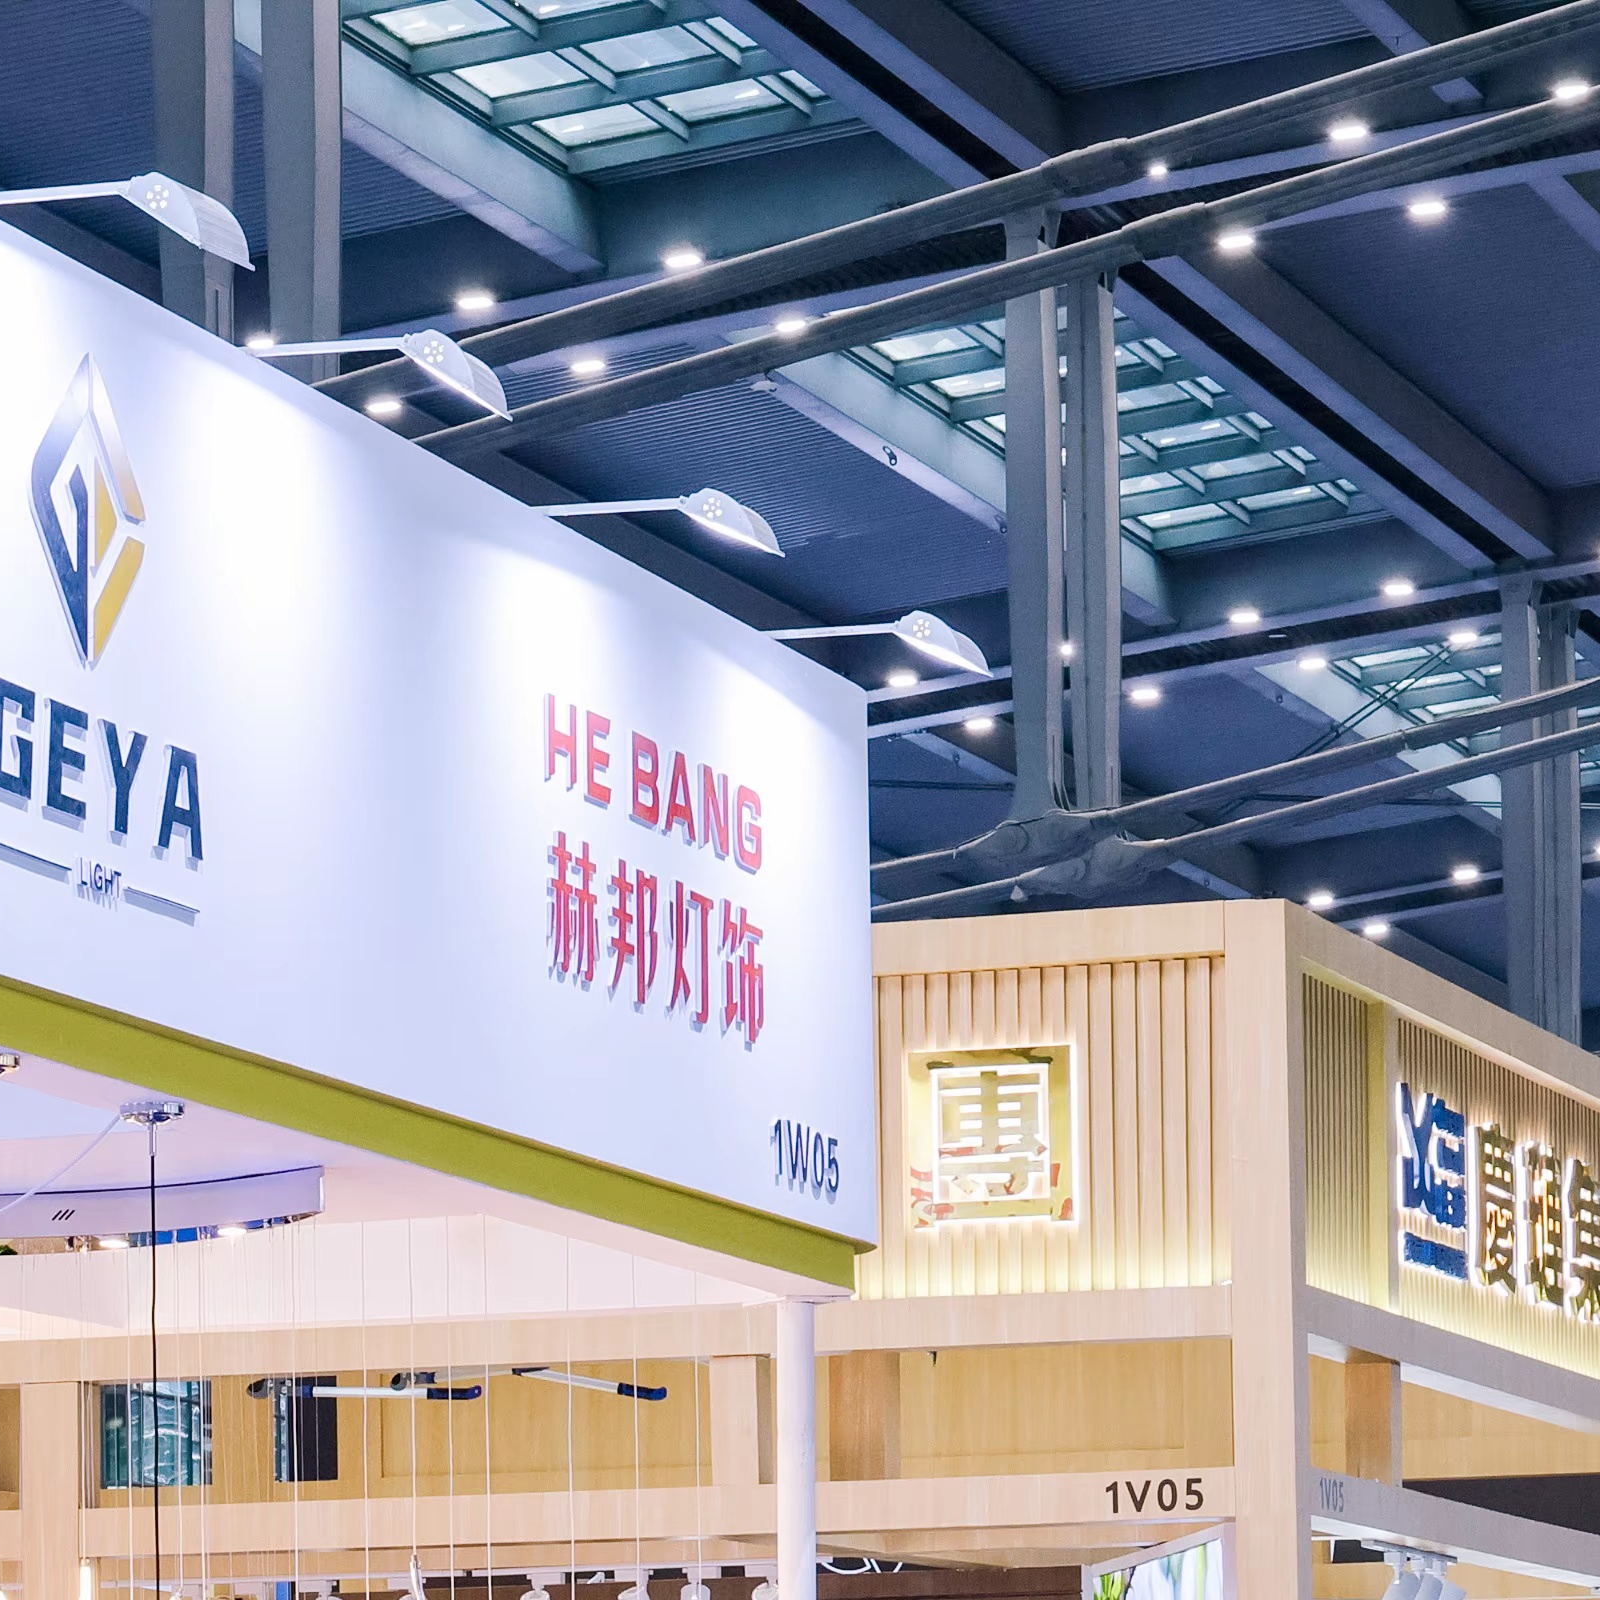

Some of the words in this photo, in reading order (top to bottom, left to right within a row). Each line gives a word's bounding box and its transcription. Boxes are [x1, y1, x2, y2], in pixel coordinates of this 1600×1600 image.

[545, 694, 611, 803] HE
[632, 731, 762, 870] BANG
[80, 858, 123, 896] LIGHT
[548, 832, 765, 1041] 赫邦灯饰
[771, 1119, 840, 1194] 1W05
[1105, 1477, 1204, 1515] 1V05
[1319, 1477, 1345, 1514] 1V05
